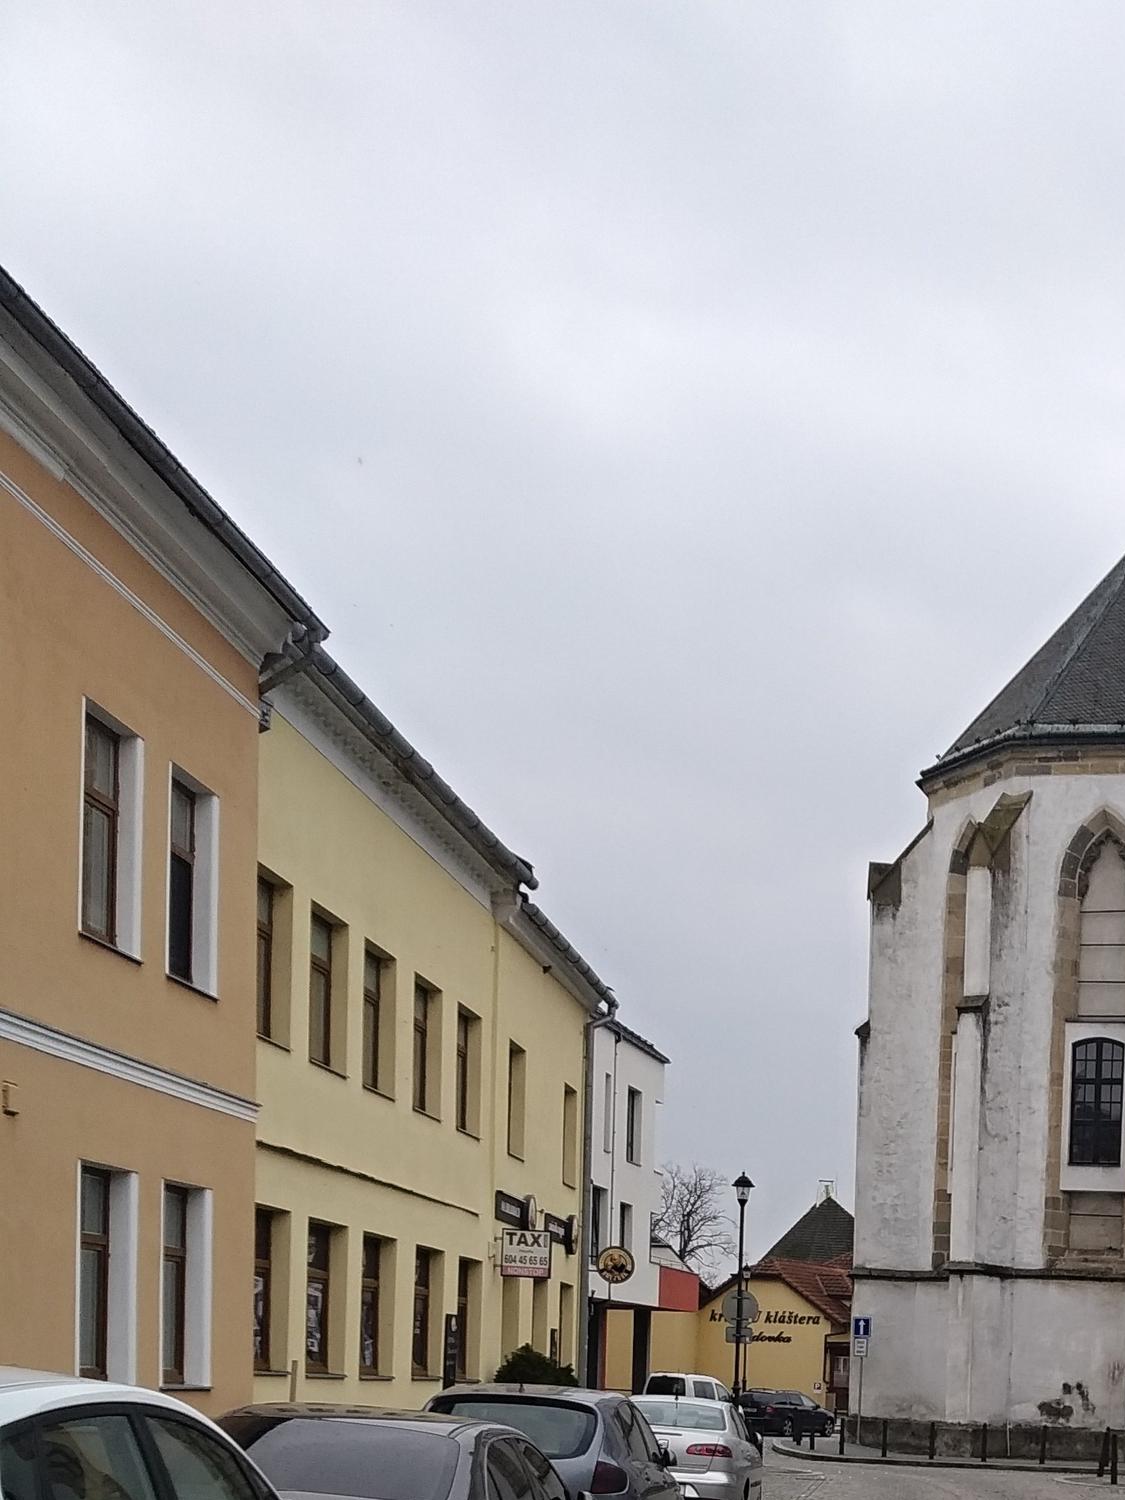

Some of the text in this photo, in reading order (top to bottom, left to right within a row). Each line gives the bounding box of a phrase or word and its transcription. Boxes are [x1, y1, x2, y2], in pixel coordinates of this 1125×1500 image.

[506, 1231, 549, 1248] TAXI
[507, 1266, 545, 1276] NONSTOP
[764, 1310, 821, 1325] kláštera
